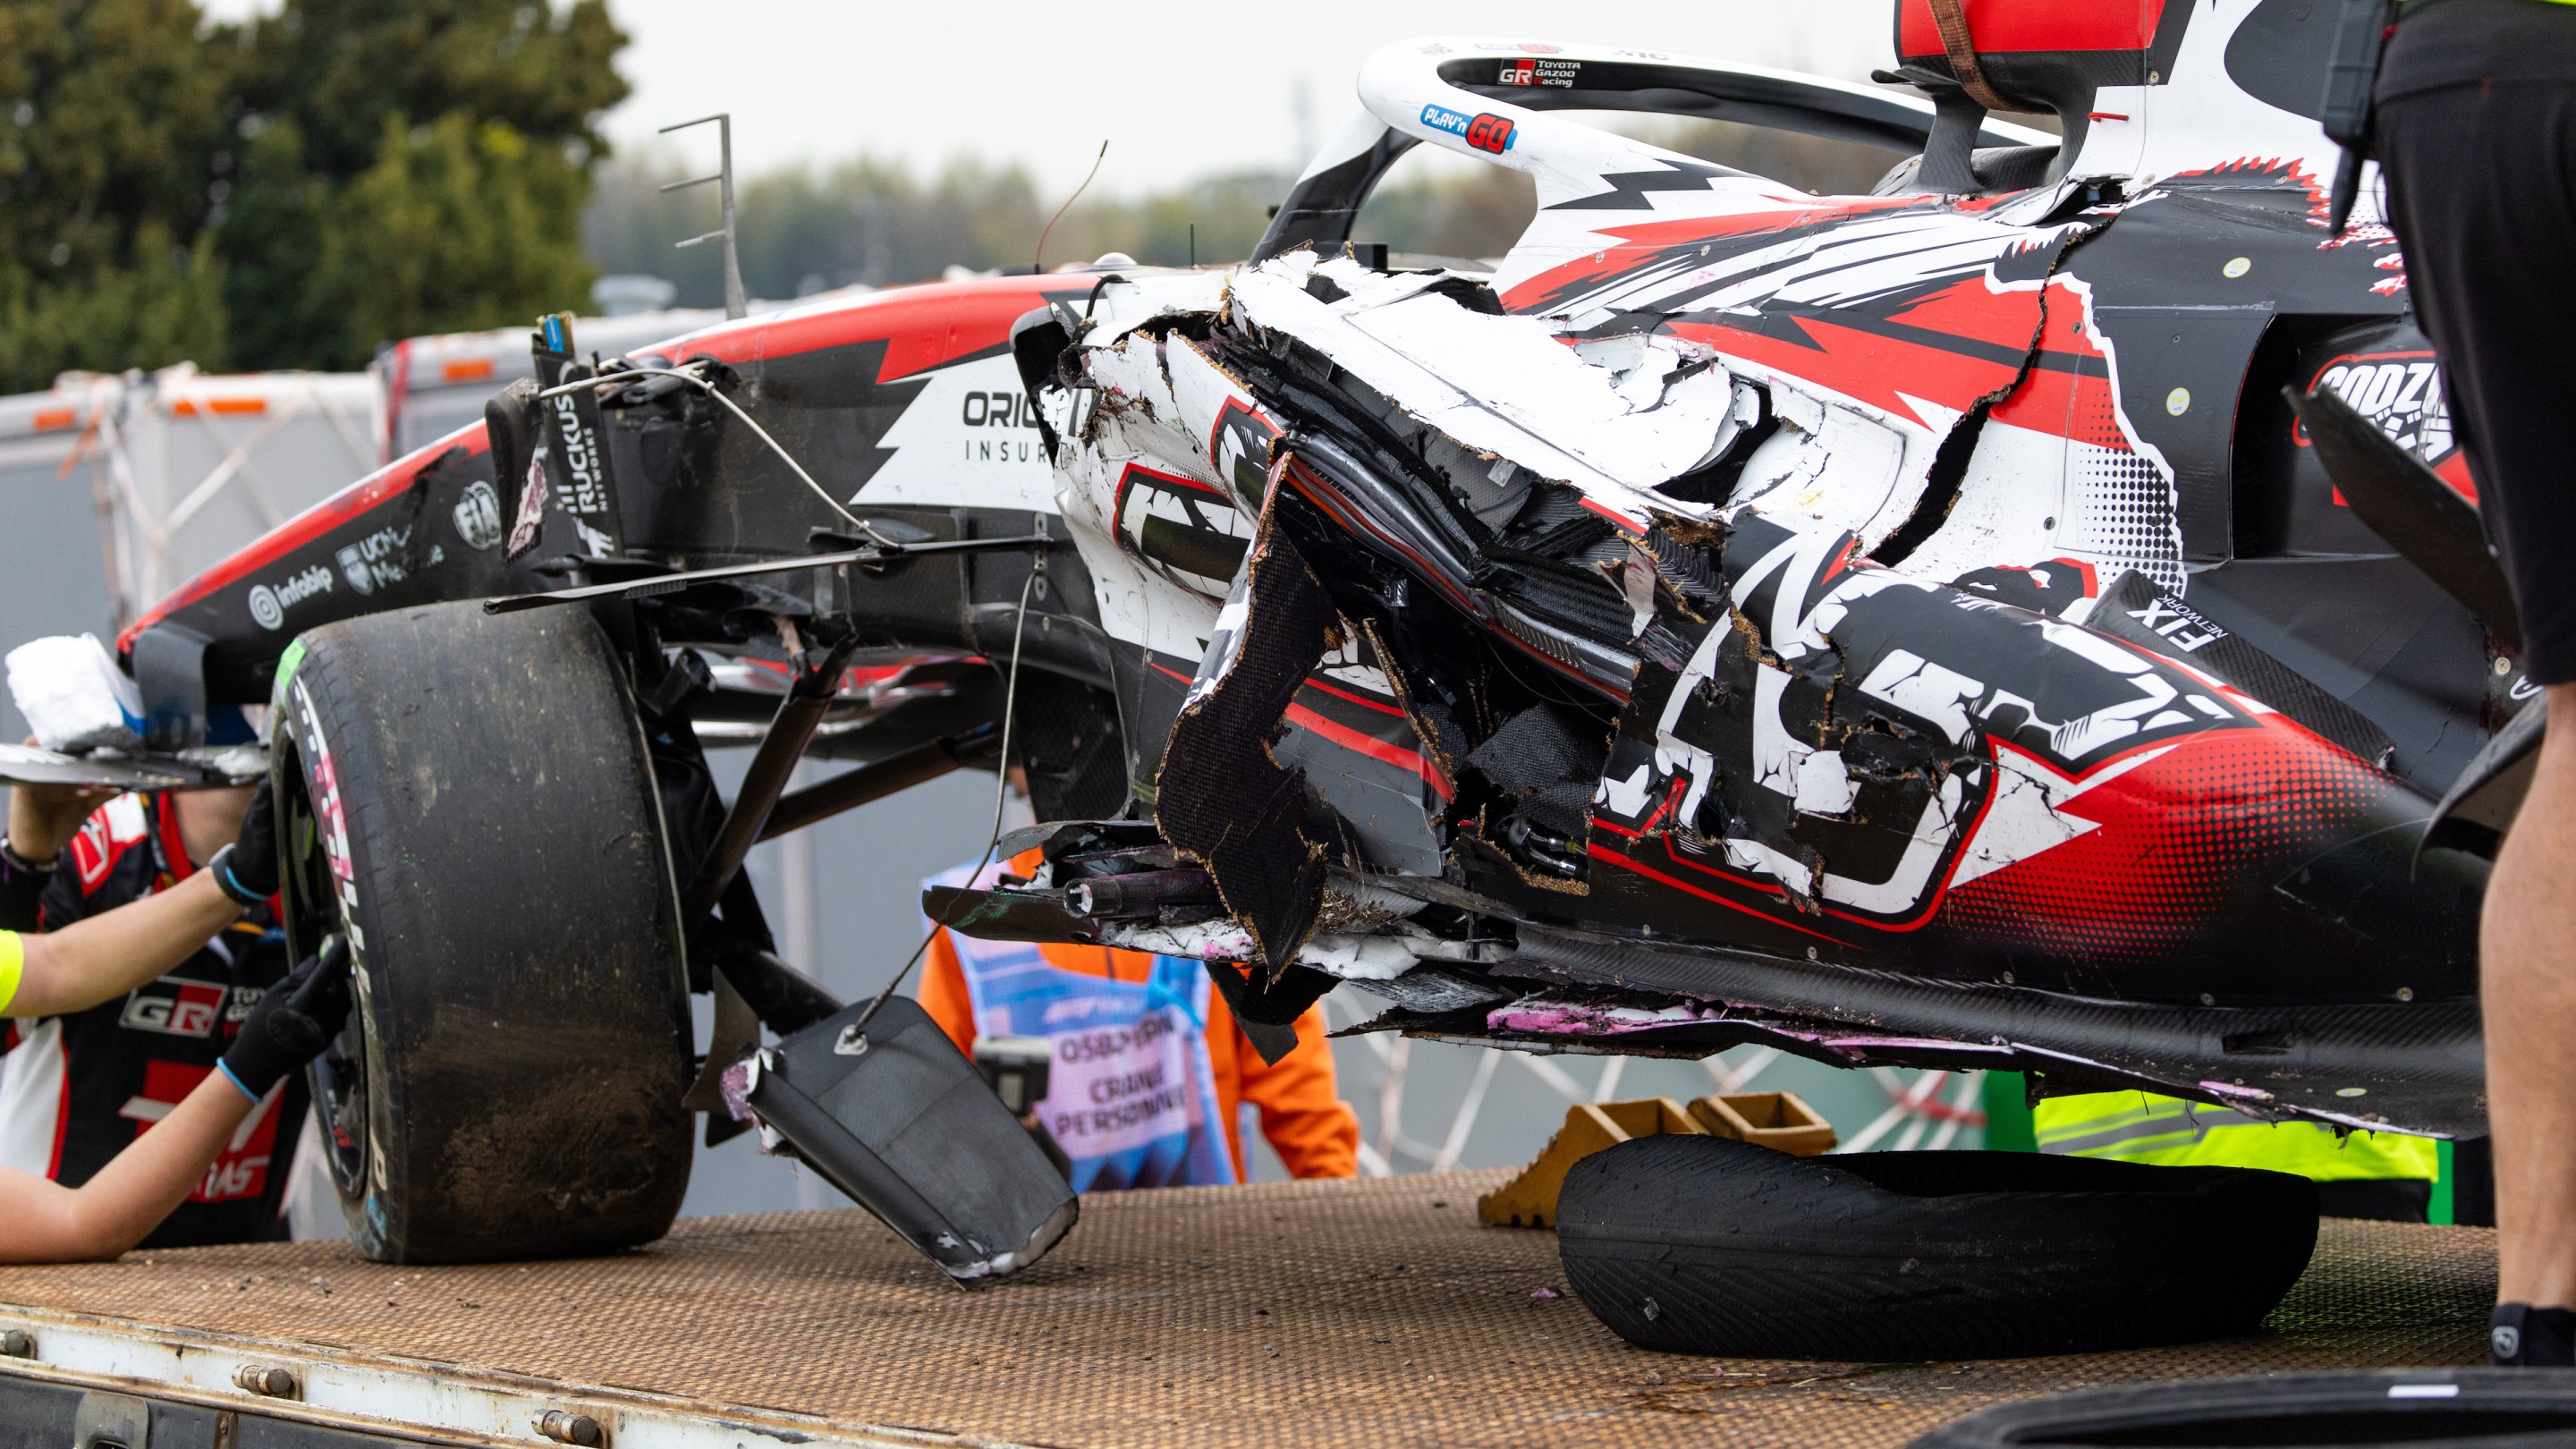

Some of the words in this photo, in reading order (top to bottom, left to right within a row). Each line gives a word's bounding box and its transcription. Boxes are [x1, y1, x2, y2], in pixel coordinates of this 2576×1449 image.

[1499, 69, 1532, 83] GR
[1533, 78, 1573, 88] Racing
[1535, 69, 1576, 78] GAZOO
[1537, 60, 1581, 69] TOYOTA
[1467, 114, 1513, 153] GO
[555, 394, 598, 513] RUCKUS
[583, 427, 608, 513] NETWORKS
[274, 565, 334, 608] infobip
[2125, 597, 2216, 653] FIX
[2157, 594, 2229, 639] NETWORK
[126, 995, 214, 1032] GR
